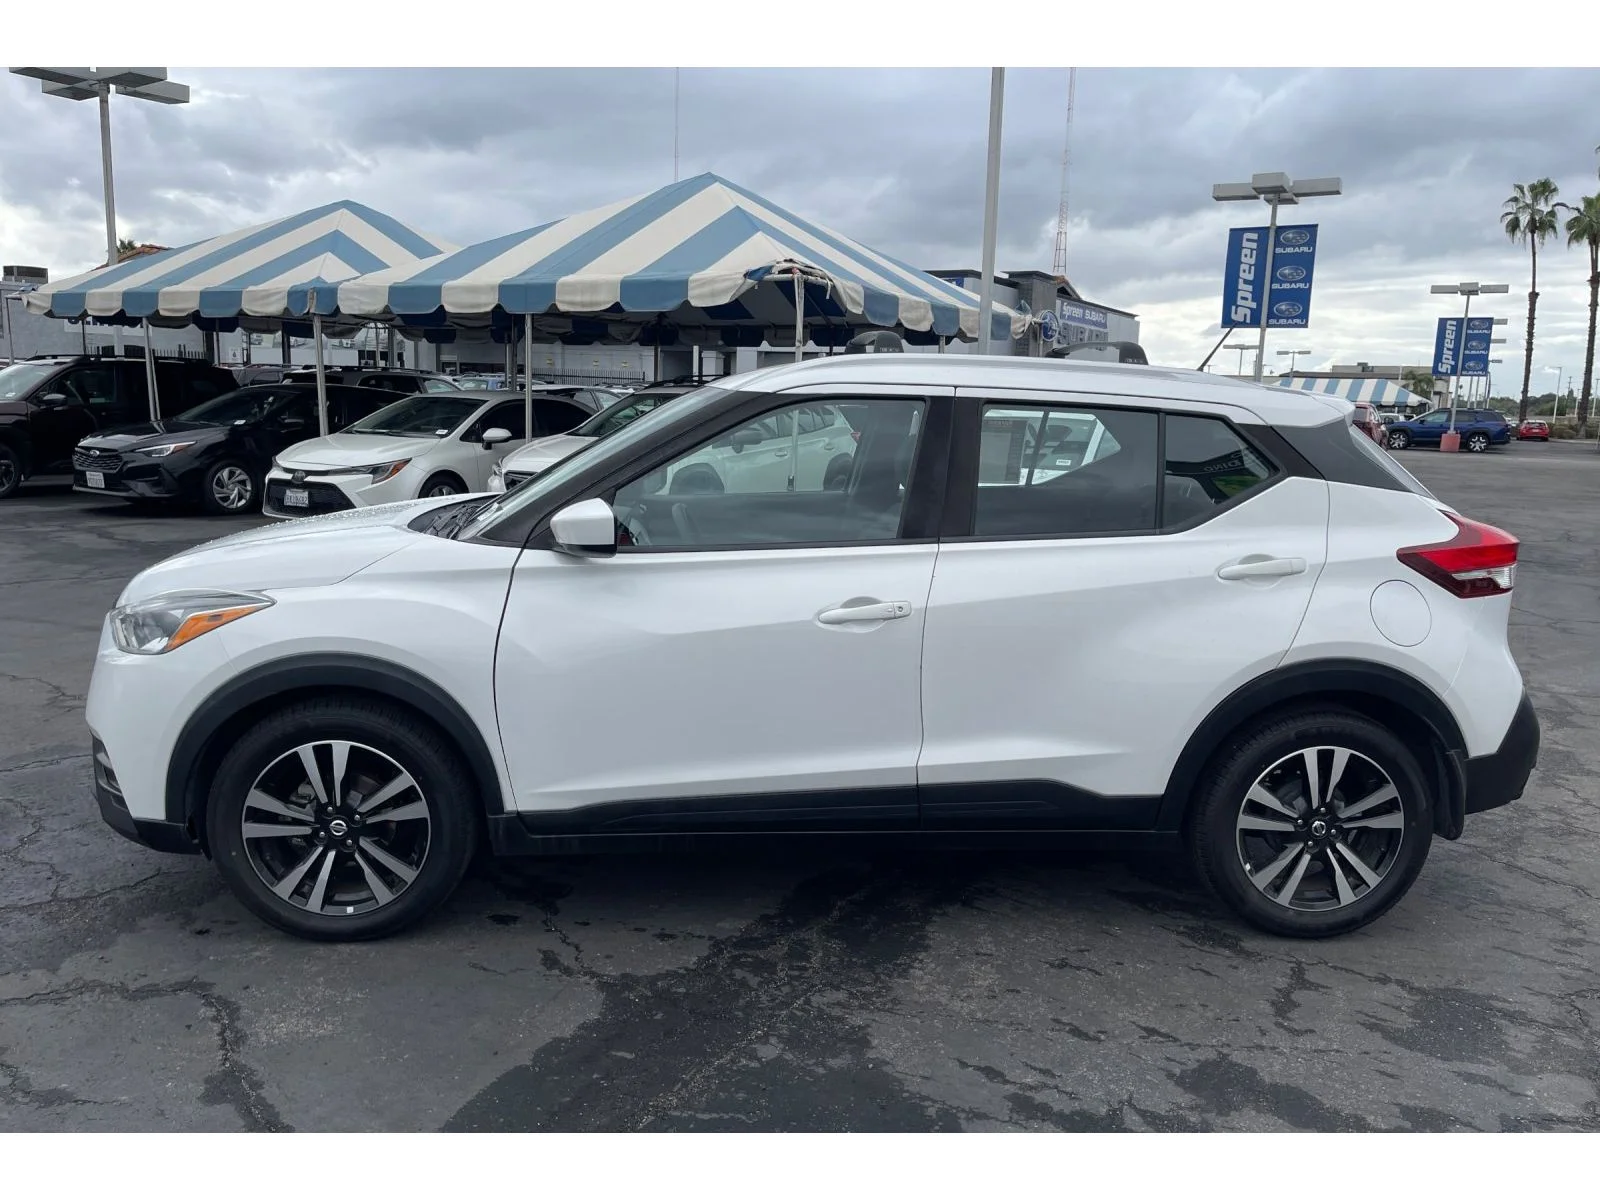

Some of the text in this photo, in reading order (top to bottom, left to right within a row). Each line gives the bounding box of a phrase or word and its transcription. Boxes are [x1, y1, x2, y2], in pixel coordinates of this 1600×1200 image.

[1231, 232, 1258, 323] Spreen
[1062, 302, 1106, 322] Spreen SUBARU
[1438, 320, 1456, 374] Spreen
